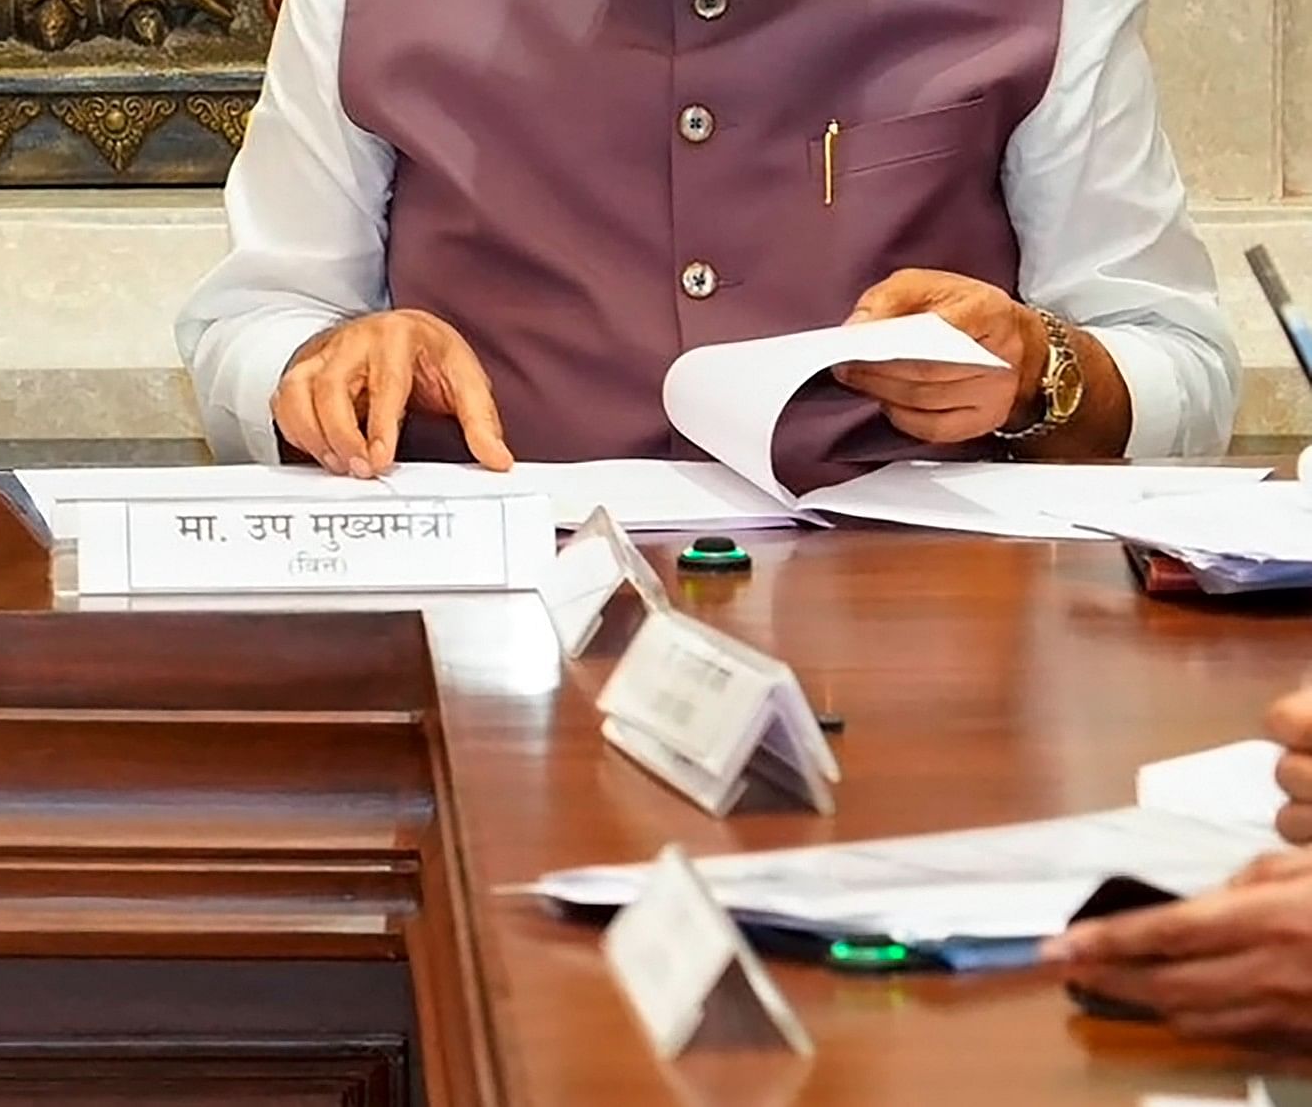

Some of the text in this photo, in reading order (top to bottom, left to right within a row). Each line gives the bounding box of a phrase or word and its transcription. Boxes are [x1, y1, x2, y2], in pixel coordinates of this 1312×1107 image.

[176, 500, 455, 552] मा. उप मुख्यमंत्री
